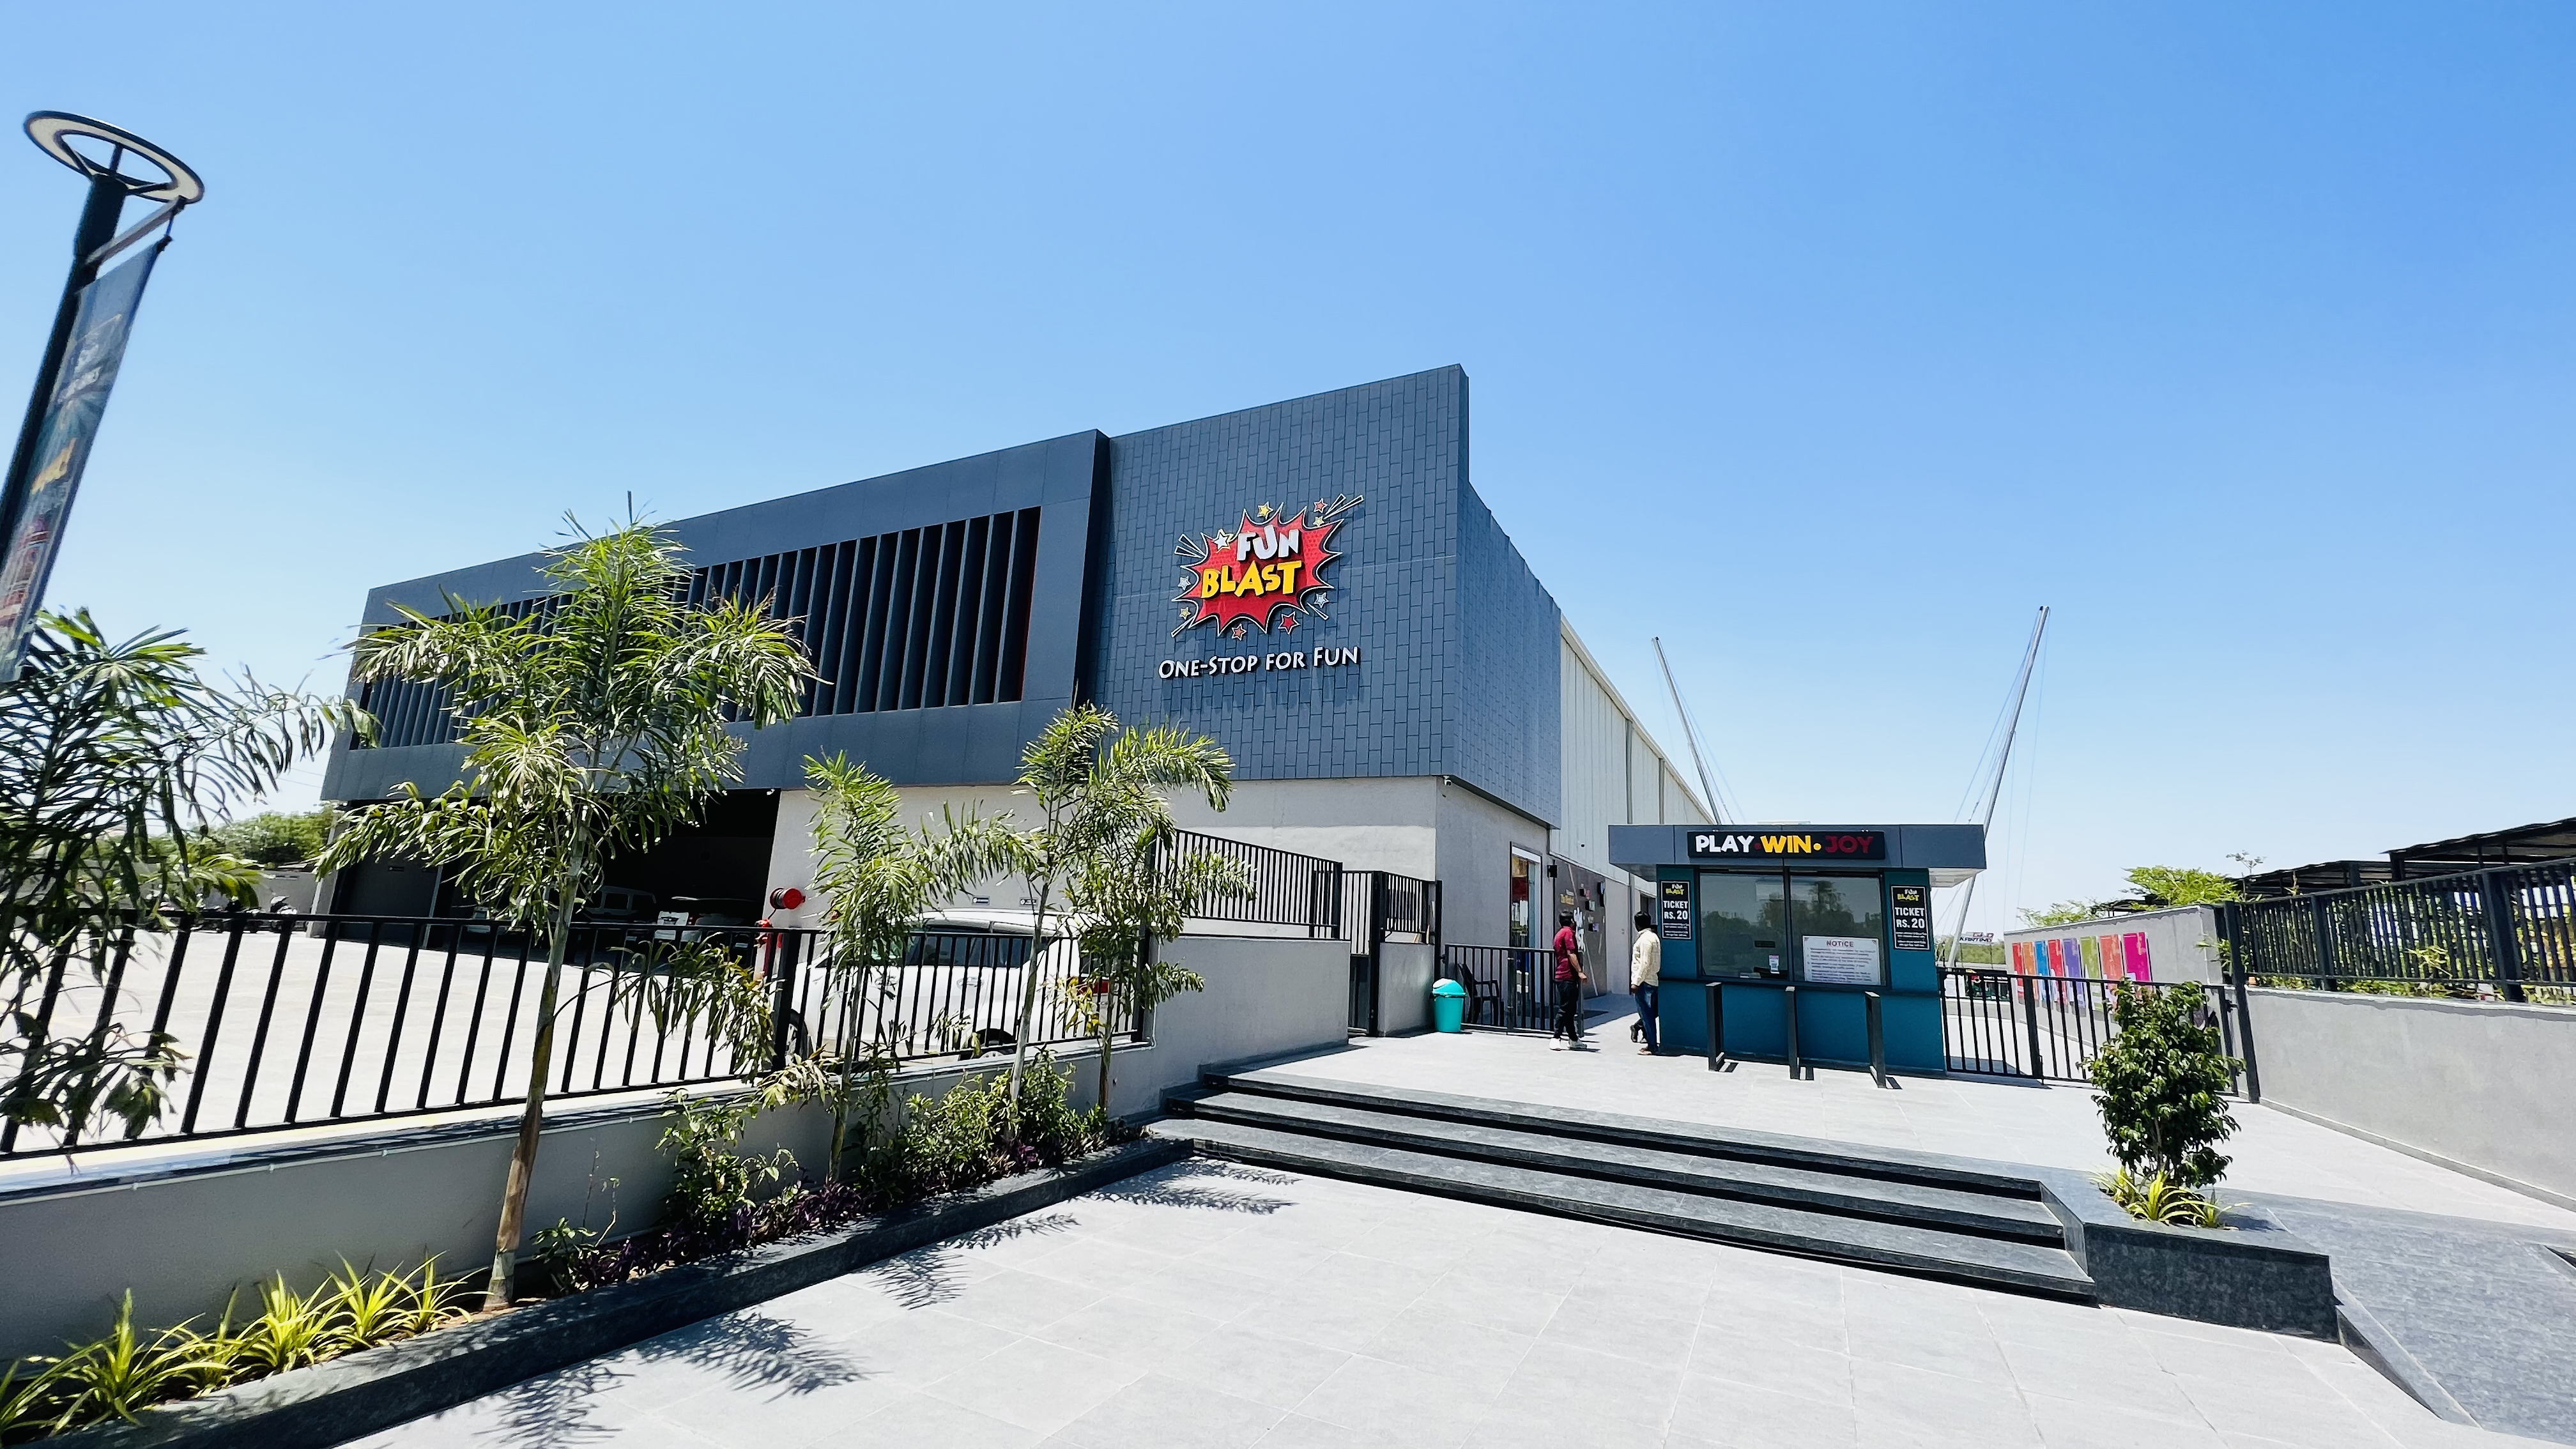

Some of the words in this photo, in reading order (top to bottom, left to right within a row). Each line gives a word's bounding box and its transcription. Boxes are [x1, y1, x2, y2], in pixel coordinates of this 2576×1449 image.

[1237, 525, 1300, 561] FUN
[1201, 560, 1302, 599] BLAST
[1266, 651, 1305, 671] FOR
[1314, 646, 1358, 666] FUN
[1696, 835, 1754, 853] PLAY
[1760, 836, 1811, 854] WIN
[1825, 836, 1874, 854] JOY
[1664, 911, 1676, 919] RS.
[1677, 910, 1688, 919] 20
[1894, 907, 1924, 916] TICKET
[1896, 919, 1910, 928] RS.
[1912, 918, 1925, 928] 20
